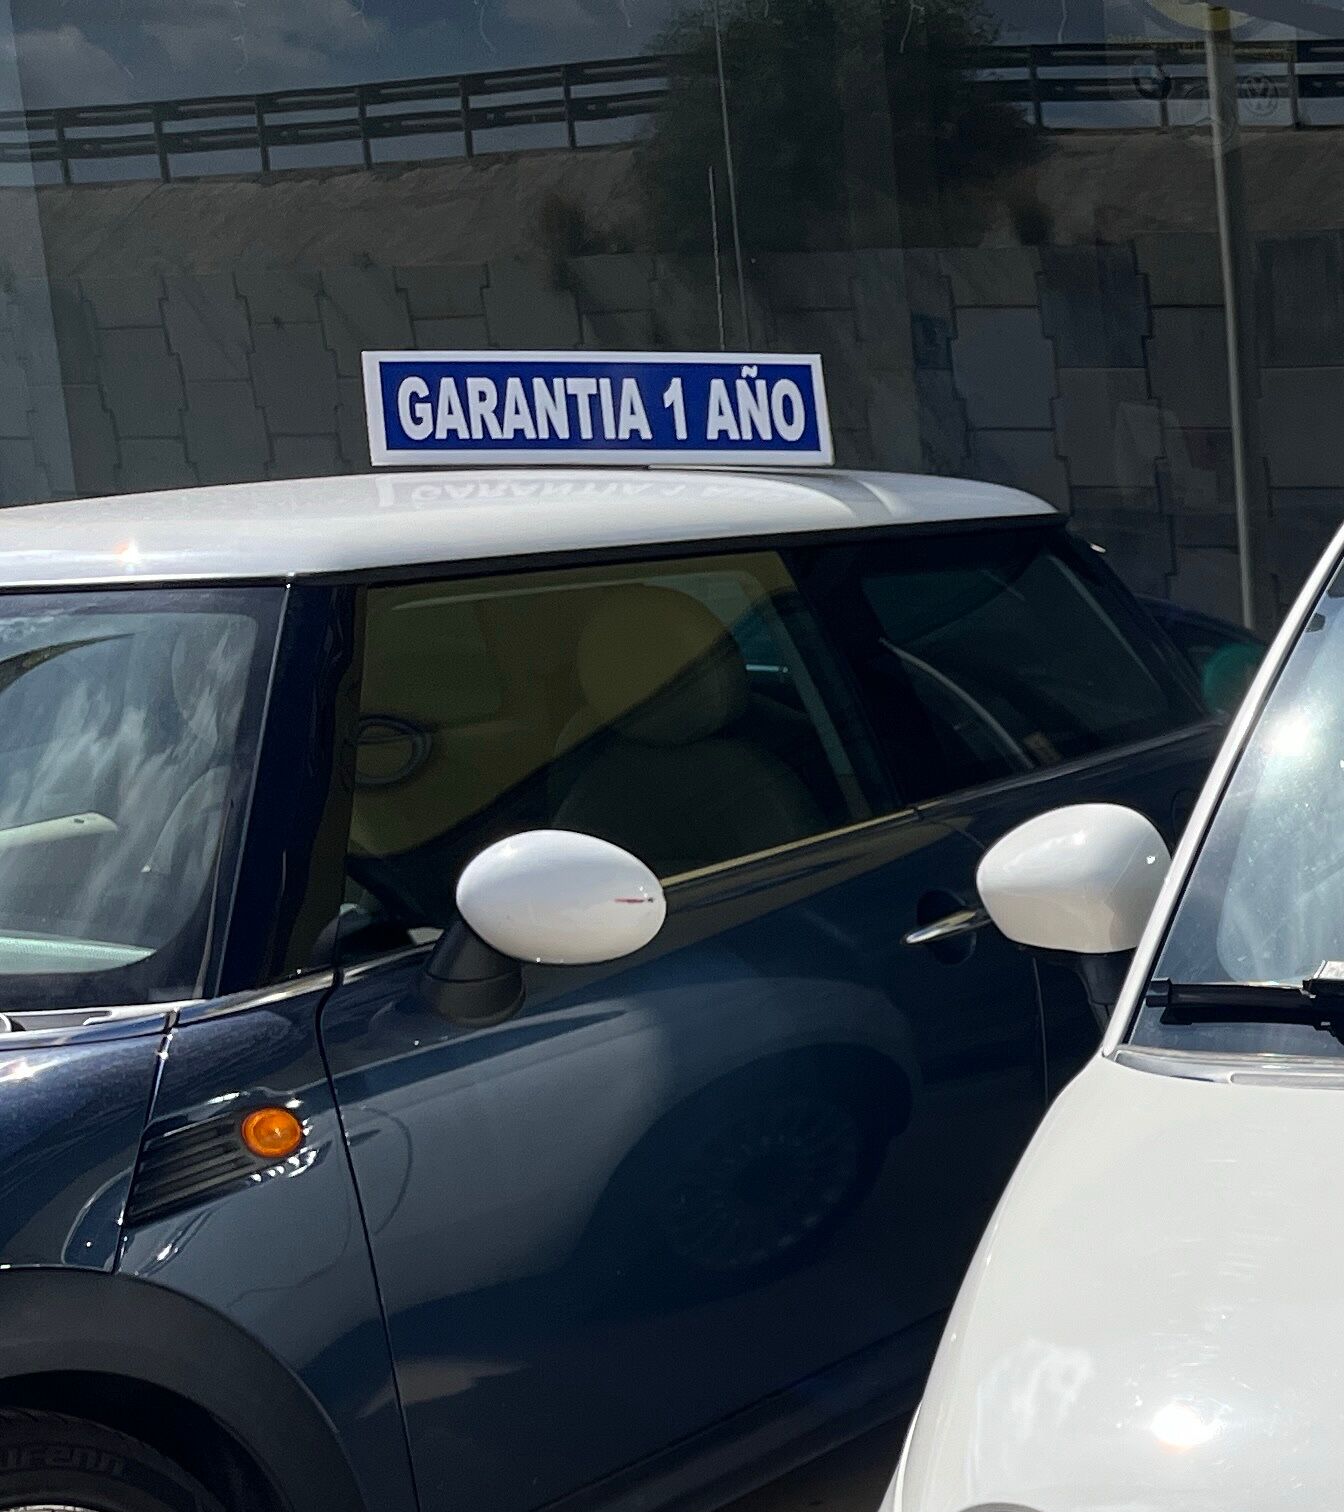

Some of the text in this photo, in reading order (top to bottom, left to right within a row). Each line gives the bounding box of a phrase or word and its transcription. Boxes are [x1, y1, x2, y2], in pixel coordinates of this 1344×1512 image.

[398, 365, 806, 442] GARANTIA 1 AÑO
